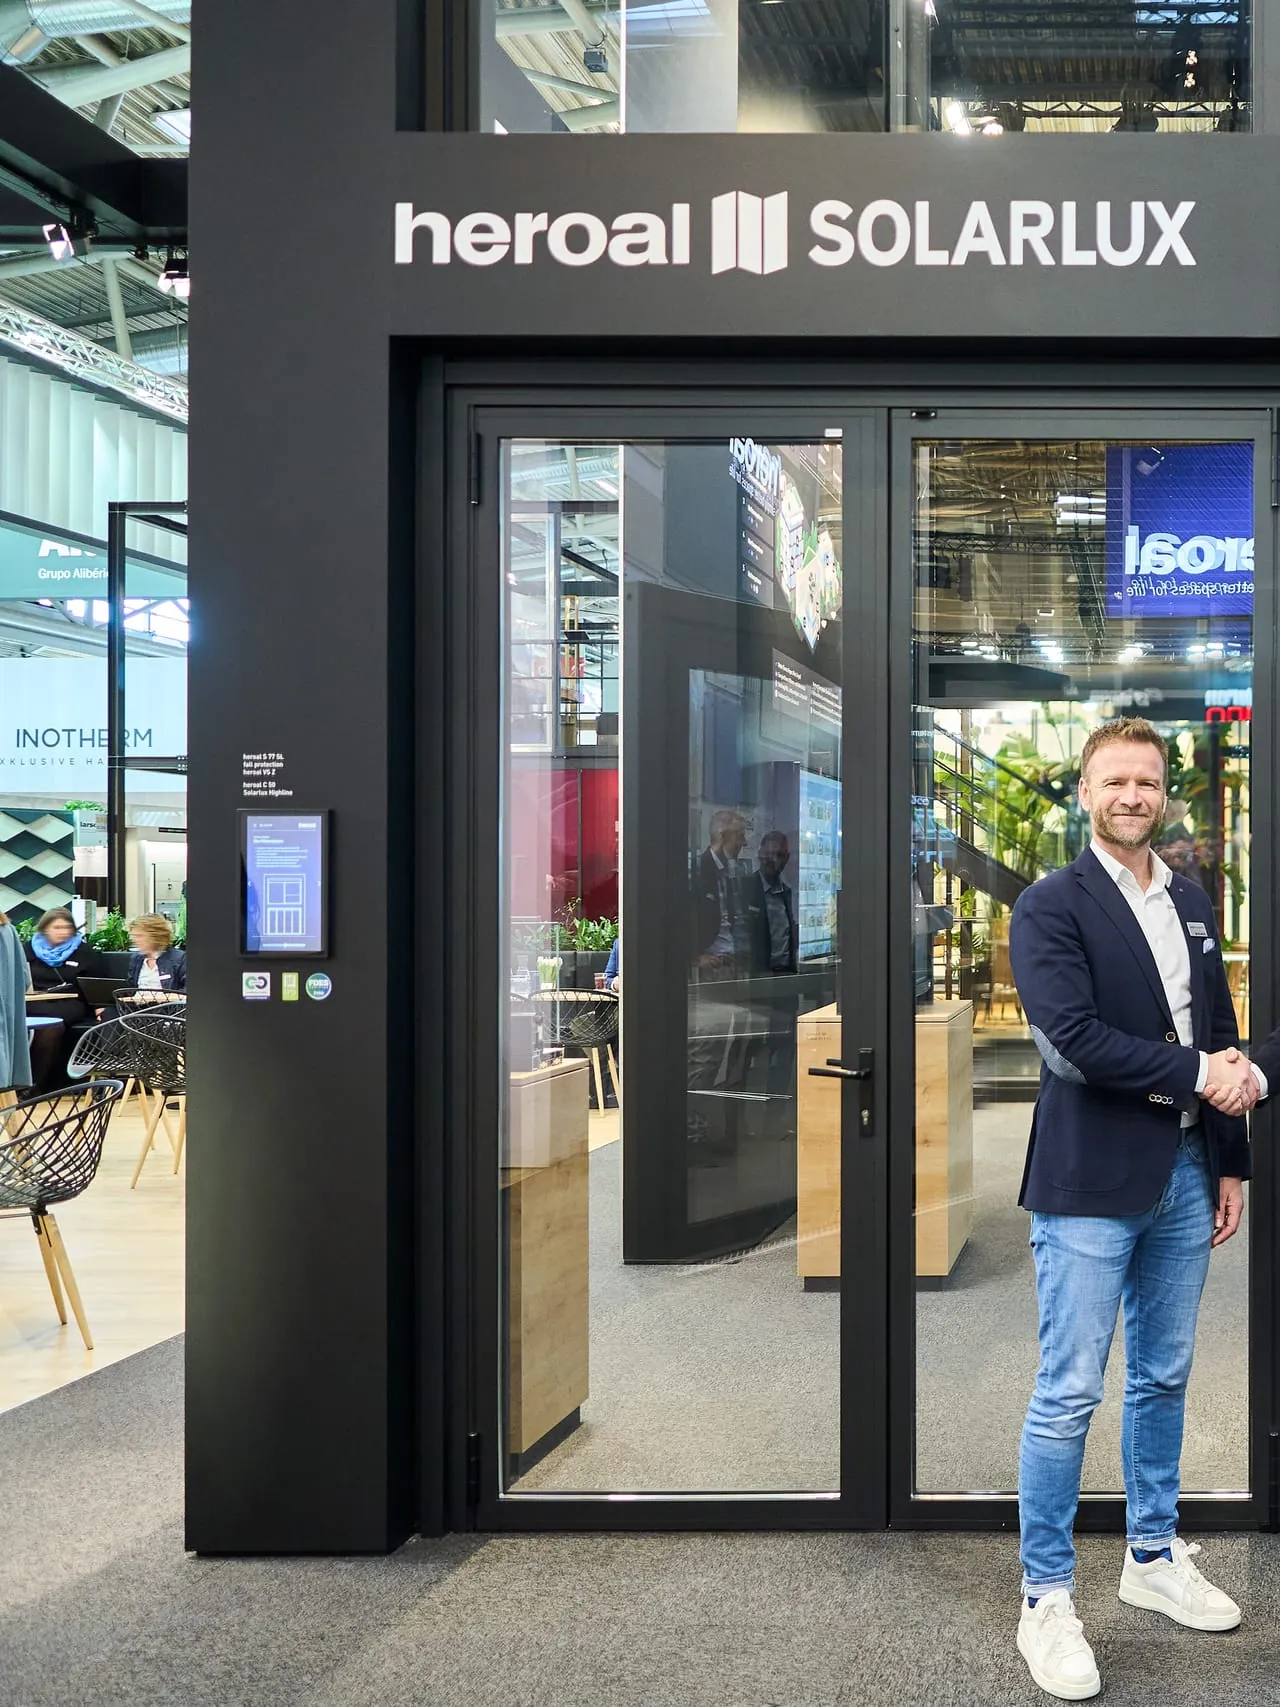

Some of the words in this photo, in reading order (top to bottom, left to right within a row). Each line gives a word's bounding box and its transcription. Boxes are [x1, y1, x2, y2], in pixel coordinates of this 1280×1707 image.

[394, 202, 690, 267] heroal
[808, 200, 1197, 268] SOLARLUX
[38, 567, 71, 580] Grupo
[0, 757, 76, 766] XKLUSIVE
[254, 761, 284, 769] protection
